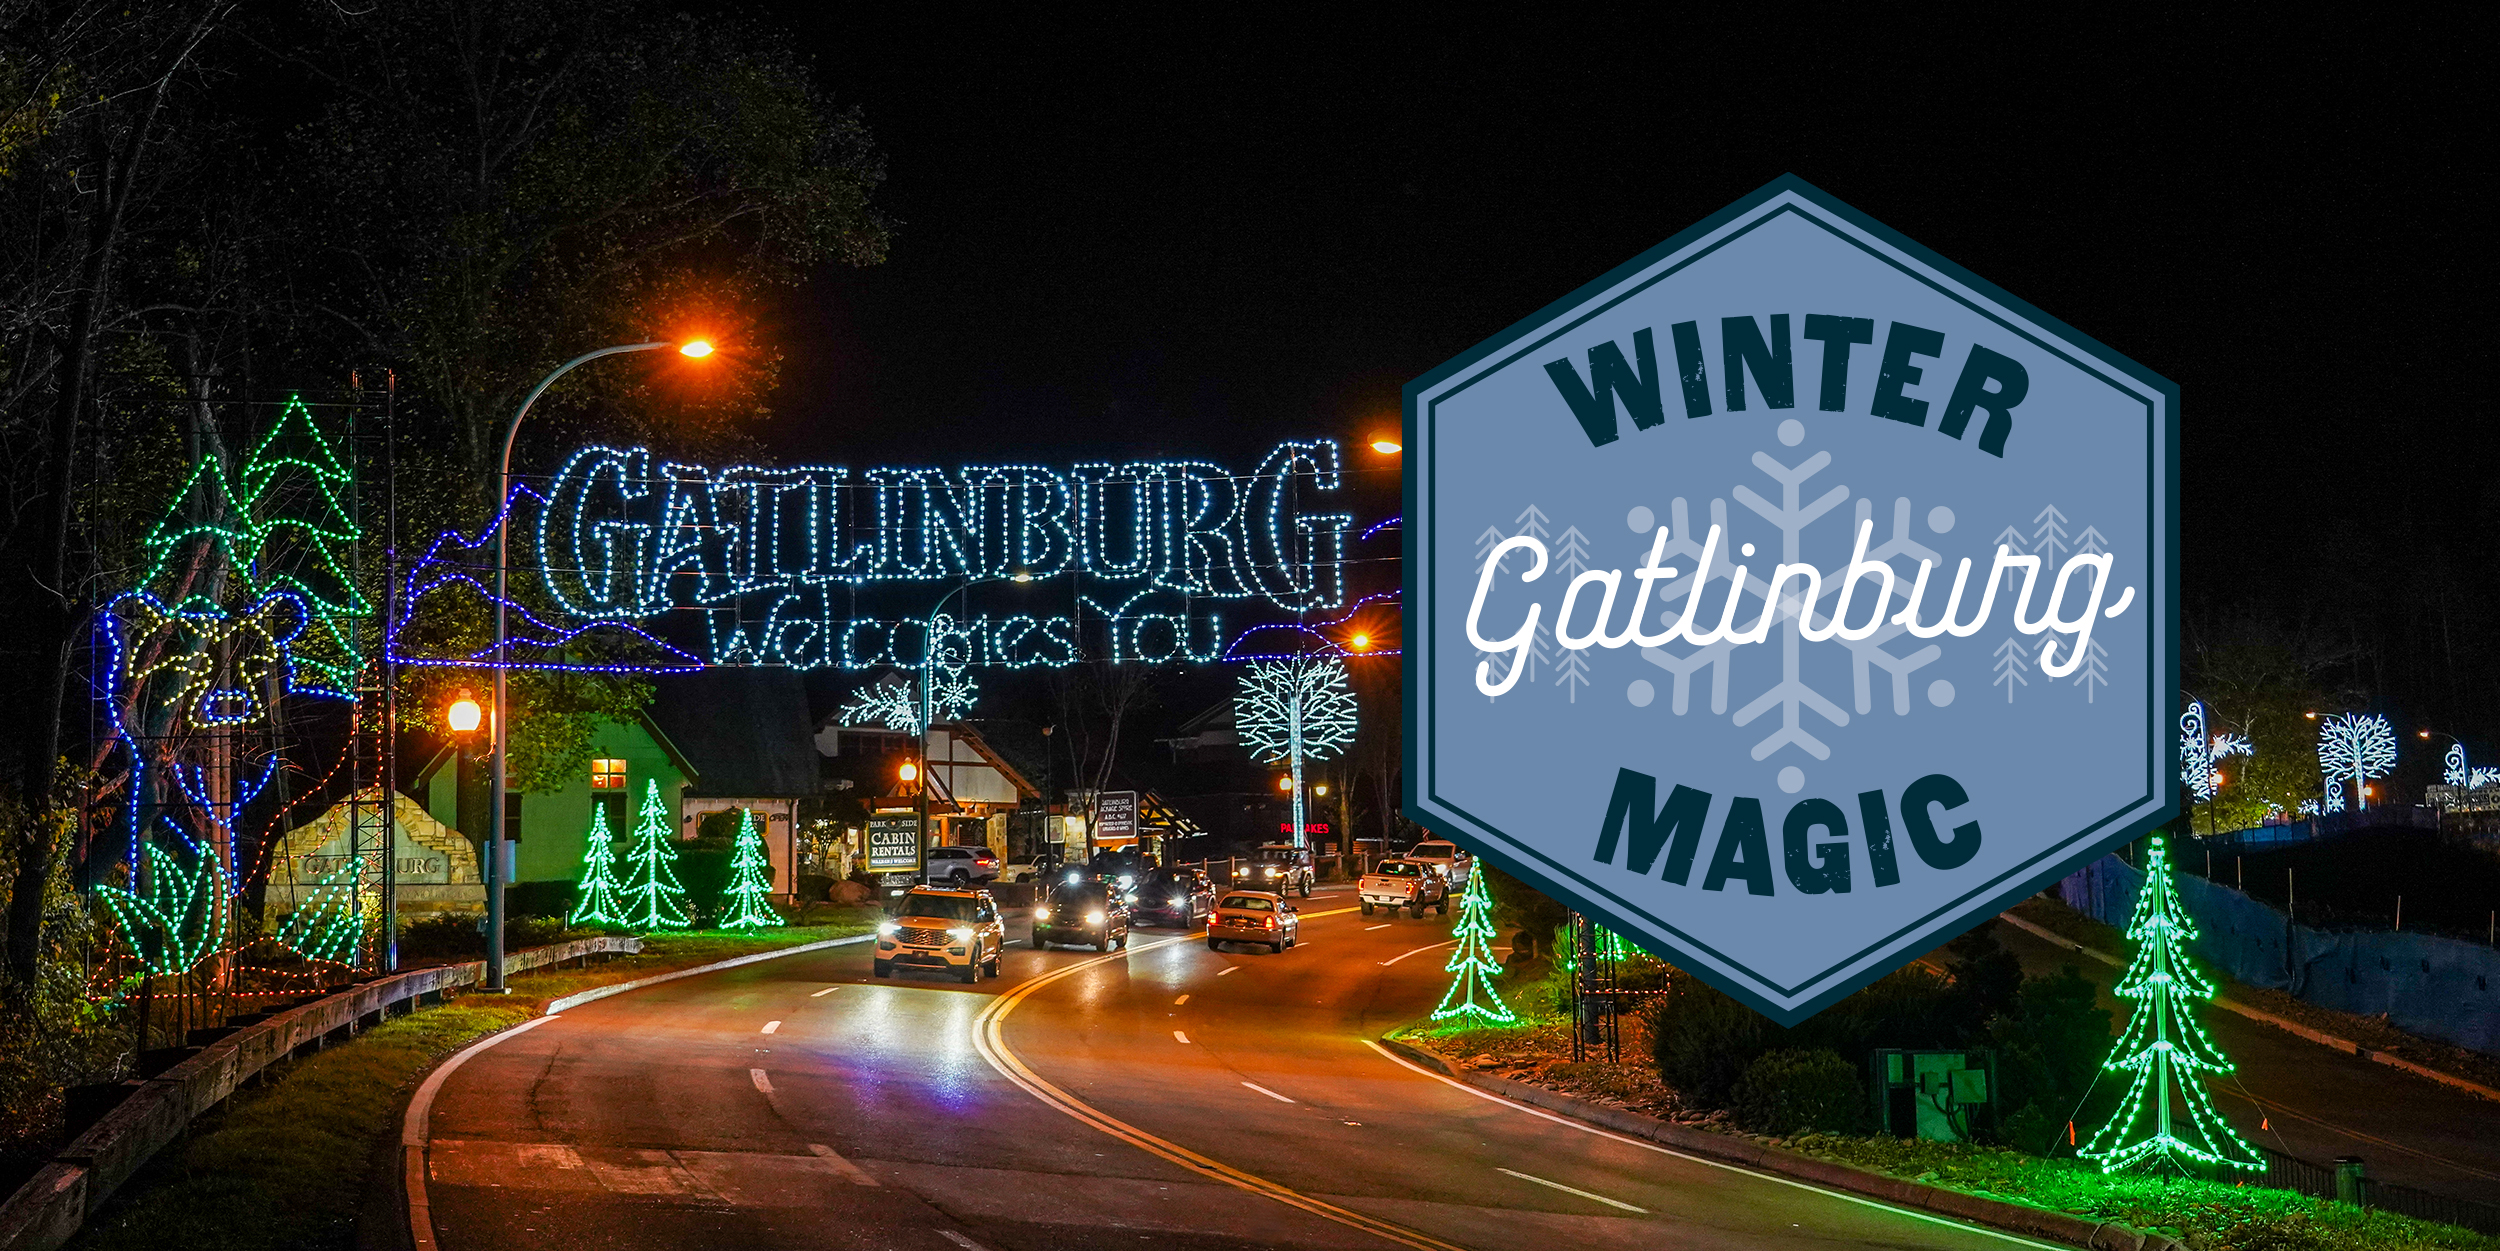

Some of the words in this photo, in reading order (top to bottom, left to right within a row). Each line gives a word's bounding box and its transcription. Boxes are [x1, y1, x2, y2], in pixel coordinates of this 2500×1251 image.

[539, 440, 1352, 617] GATLINBURG
[1078, 588, 1221, 663] You
[870, 820, 887, 828] PARK
[1280, 823, 1329, 834] PAAKES
[871, 832, 916, 845] CABIN
[871, 846, 916, 857] RENTALS
